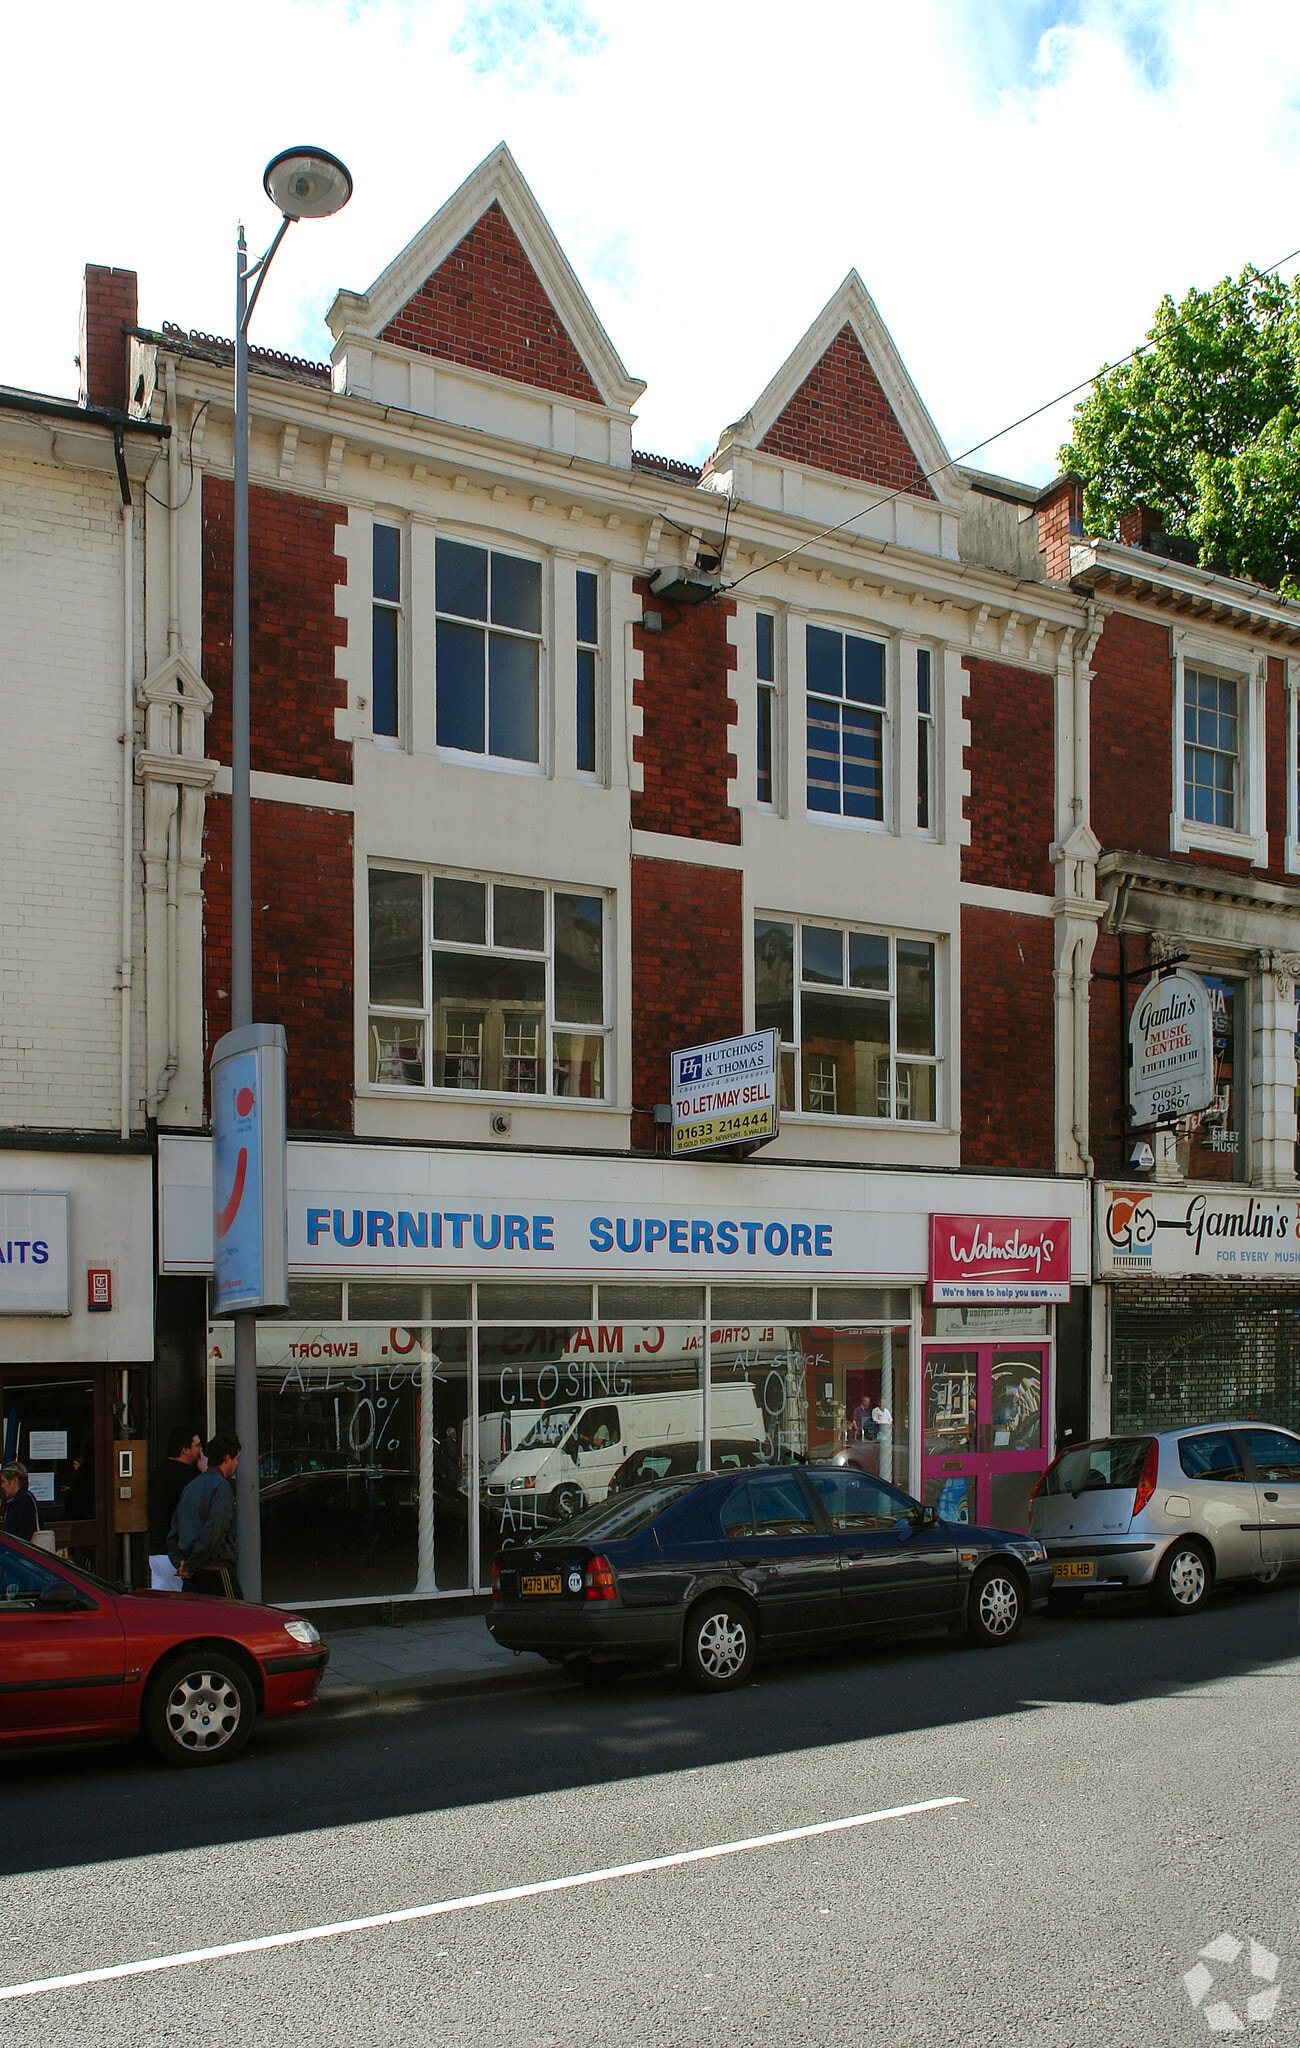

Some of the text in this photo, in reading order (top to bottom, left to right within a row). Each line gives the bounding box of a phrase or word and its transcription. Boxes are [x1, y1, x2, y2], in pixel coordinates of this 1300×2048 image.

[1139, 993, 1196, 1041] Gamlin's
[1145, 1033, 1192, 1058] CENTRE
[1150, 1023, 1188, 1045] MUSIC
[704, 1040, 764, 1063] HUTCHINGS
[705, 1055, 764, 1077] & THOMAS
[680, 1070, 769, 1093] Chartered Surveyors
[1152, 1085, 1182, 1101] 01633
[676, 1083, 771, 1117] TO LET/MAY SELL
[1150, 1093, 1190, 1116] 263867
[677, 1112, 768, 1141] 01633 214444
[1212, 1130, 1240, 1142] SHEET
[1212, 1141, 1240, 1153] MUSIC
[306, 1208, 833, 1257] FURNITURE SUPERSTORE
[1185, 1194, 1289, 1256] Gamlin's
[950, 1223, 1054, 1274] Walmsley's
[1216, 1251, 1236, 1261] FOR
[1240, 1251, 1269, 1262] EVERY
[942, 1287, 964, 1297] We're
[966, 1287, 984, 1297] here
[986, 1287, 995, 1297] to
[996, 1287, 1013, 1299] help
[1014, 1289, 1029, 1299] you
[732, 1349, 830, 1372] ALL STOCK
[924, 1362, 947, 1380] ALL
[279, 1360, 448, 1395] ALL STOCK
[500, 1359, 632, 1405] CLOSING
[929, 1382, 977, 1402] STOCK
[333, 1396, 401, 1452] 10%
[500, 1493, 548, 1534] ALL
[1070, 1563, 1090, 1575] LHB
[522, 1575, 560, 1591] M379 MCY
